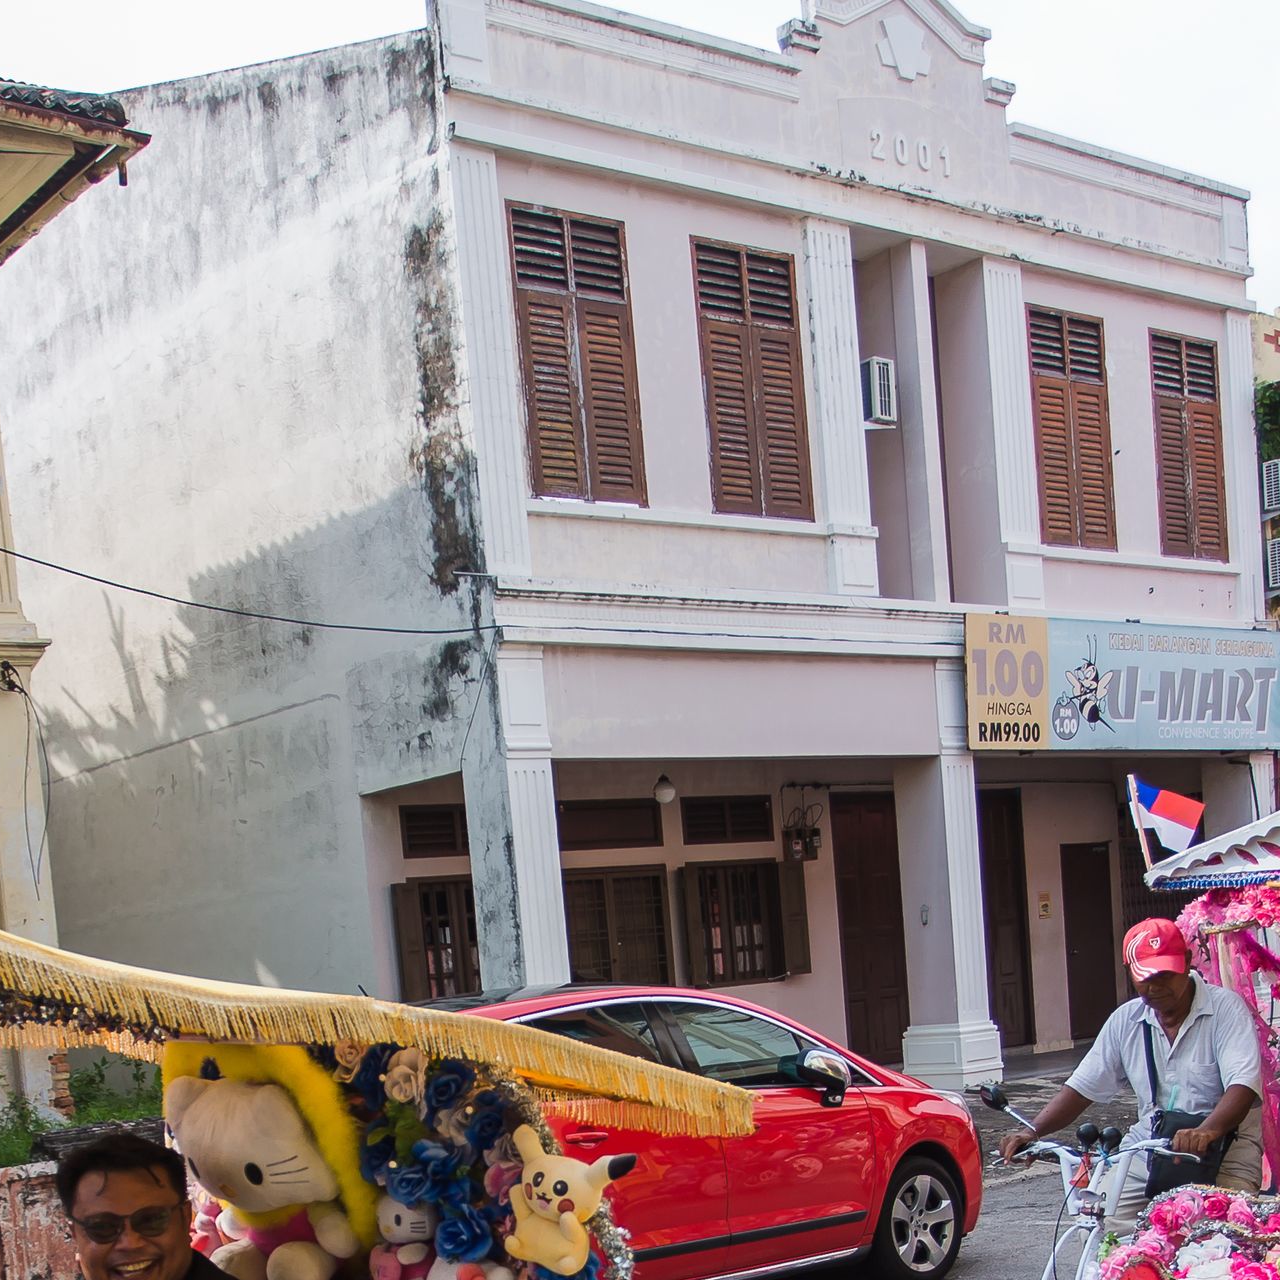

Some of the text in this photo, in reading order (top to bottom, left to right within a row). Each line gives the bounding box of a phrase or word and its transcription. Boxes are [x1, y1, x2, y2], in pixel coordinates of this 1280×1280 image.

[869, 127, 952, 178] 2001
[987, 621, 1027, 645] RM
[1108, 632, 1145, 652] KEDAI
[1148, 635, 1212, 656] BARANGAN
[1214, 638, 1276, 658] SERBAGUNA
[971, 648, 1045, 699] 1.00
[986, 701, 1033, 717] HINGGA
[1106, 665, 1279, 735] U-MART
[1059, 708, 1072, 718] RM
[978, 721, 1041, 744] RM99.00
[1054, 718, 1077, 734] 1.00
[1157, 726, 1255, 740] CONVENIENCE SHOPPE
